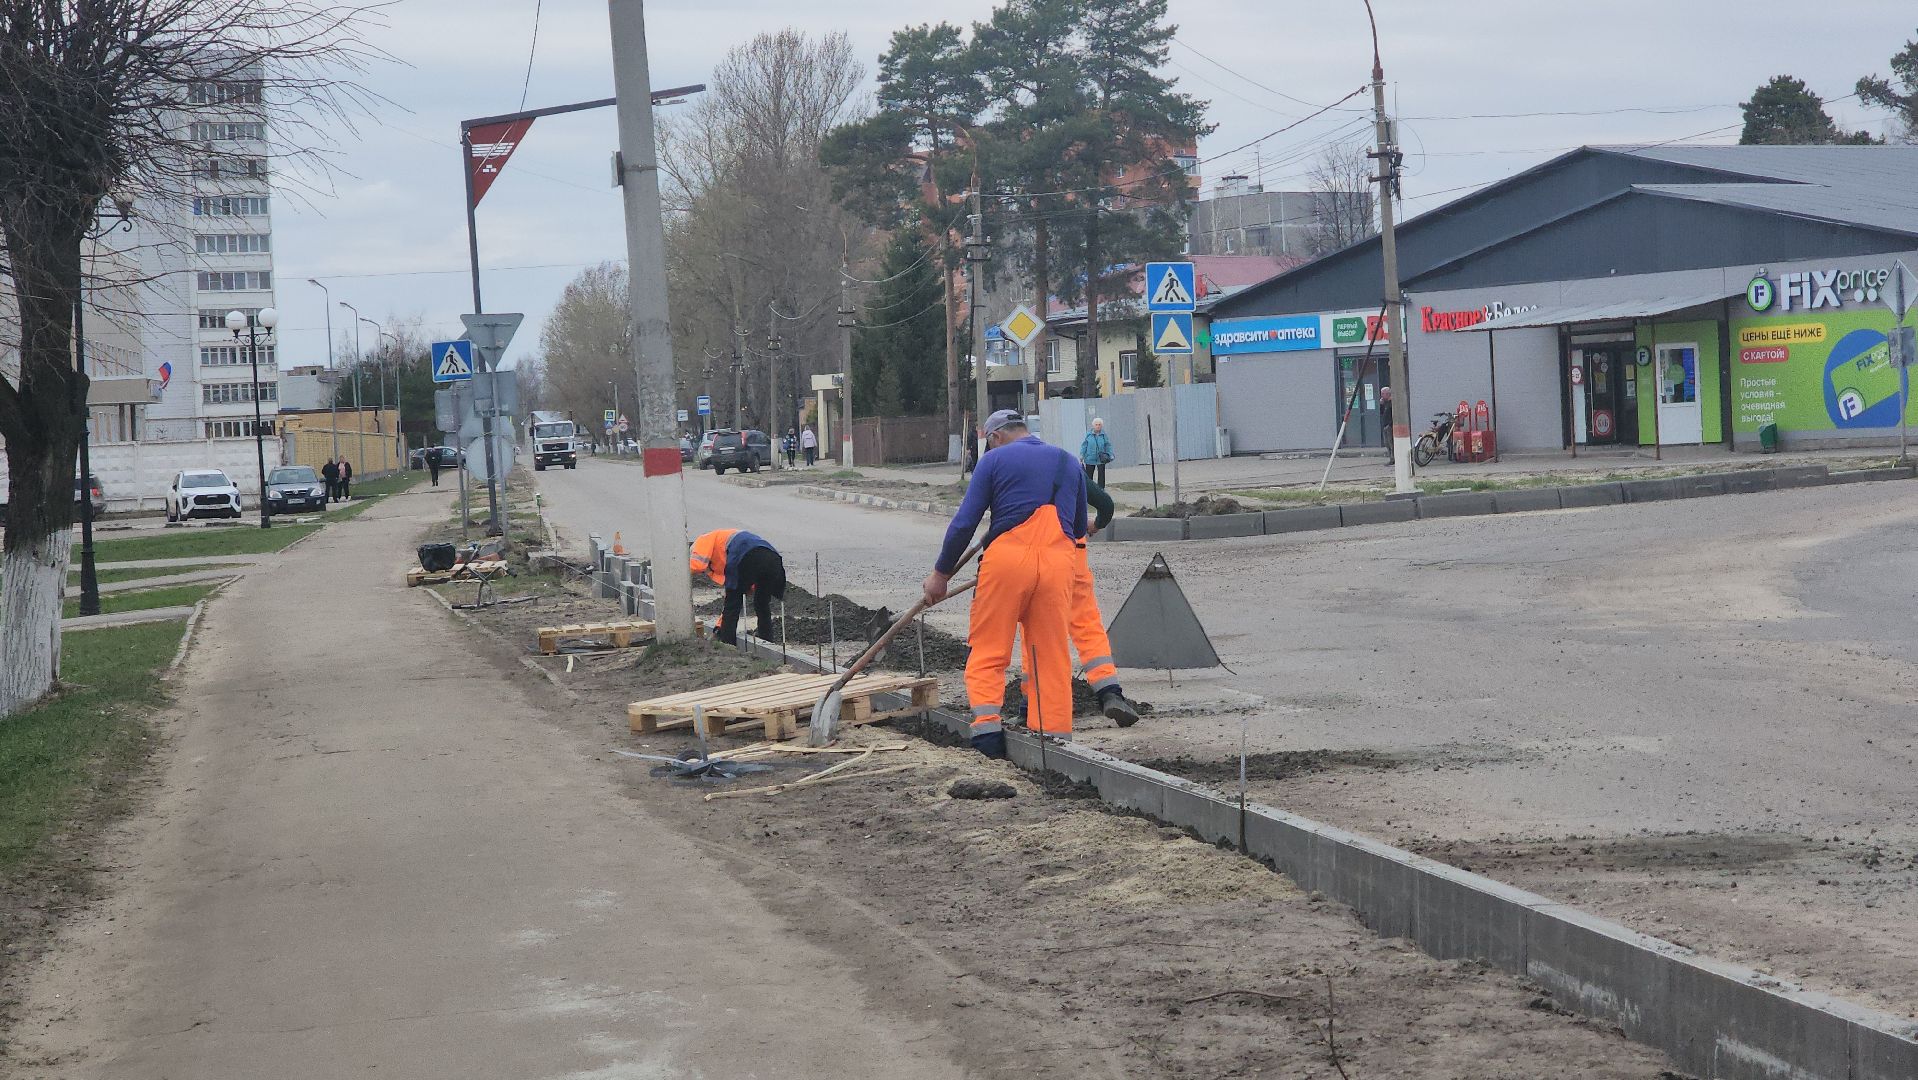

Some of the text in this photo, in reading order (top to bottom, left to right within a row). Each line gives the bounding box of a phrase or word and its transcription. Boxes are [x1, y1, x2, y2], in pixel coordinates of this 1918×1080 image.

[1838, 268, 1890, 295] price
[1214, 327, 1316, 347] здравсити аптека
[1742, 331, 1769, 342] ЦЕНЫ
[1793, 328, 1822, 338] НИЖЕ
[1743, 348, 1785, 360] С КАРТОЙ!
[1740, 378, 1777, 388] Простые
[1740, 401, 1786, 411] очевидная
[1741, 412, 1774, 422] выгода!
